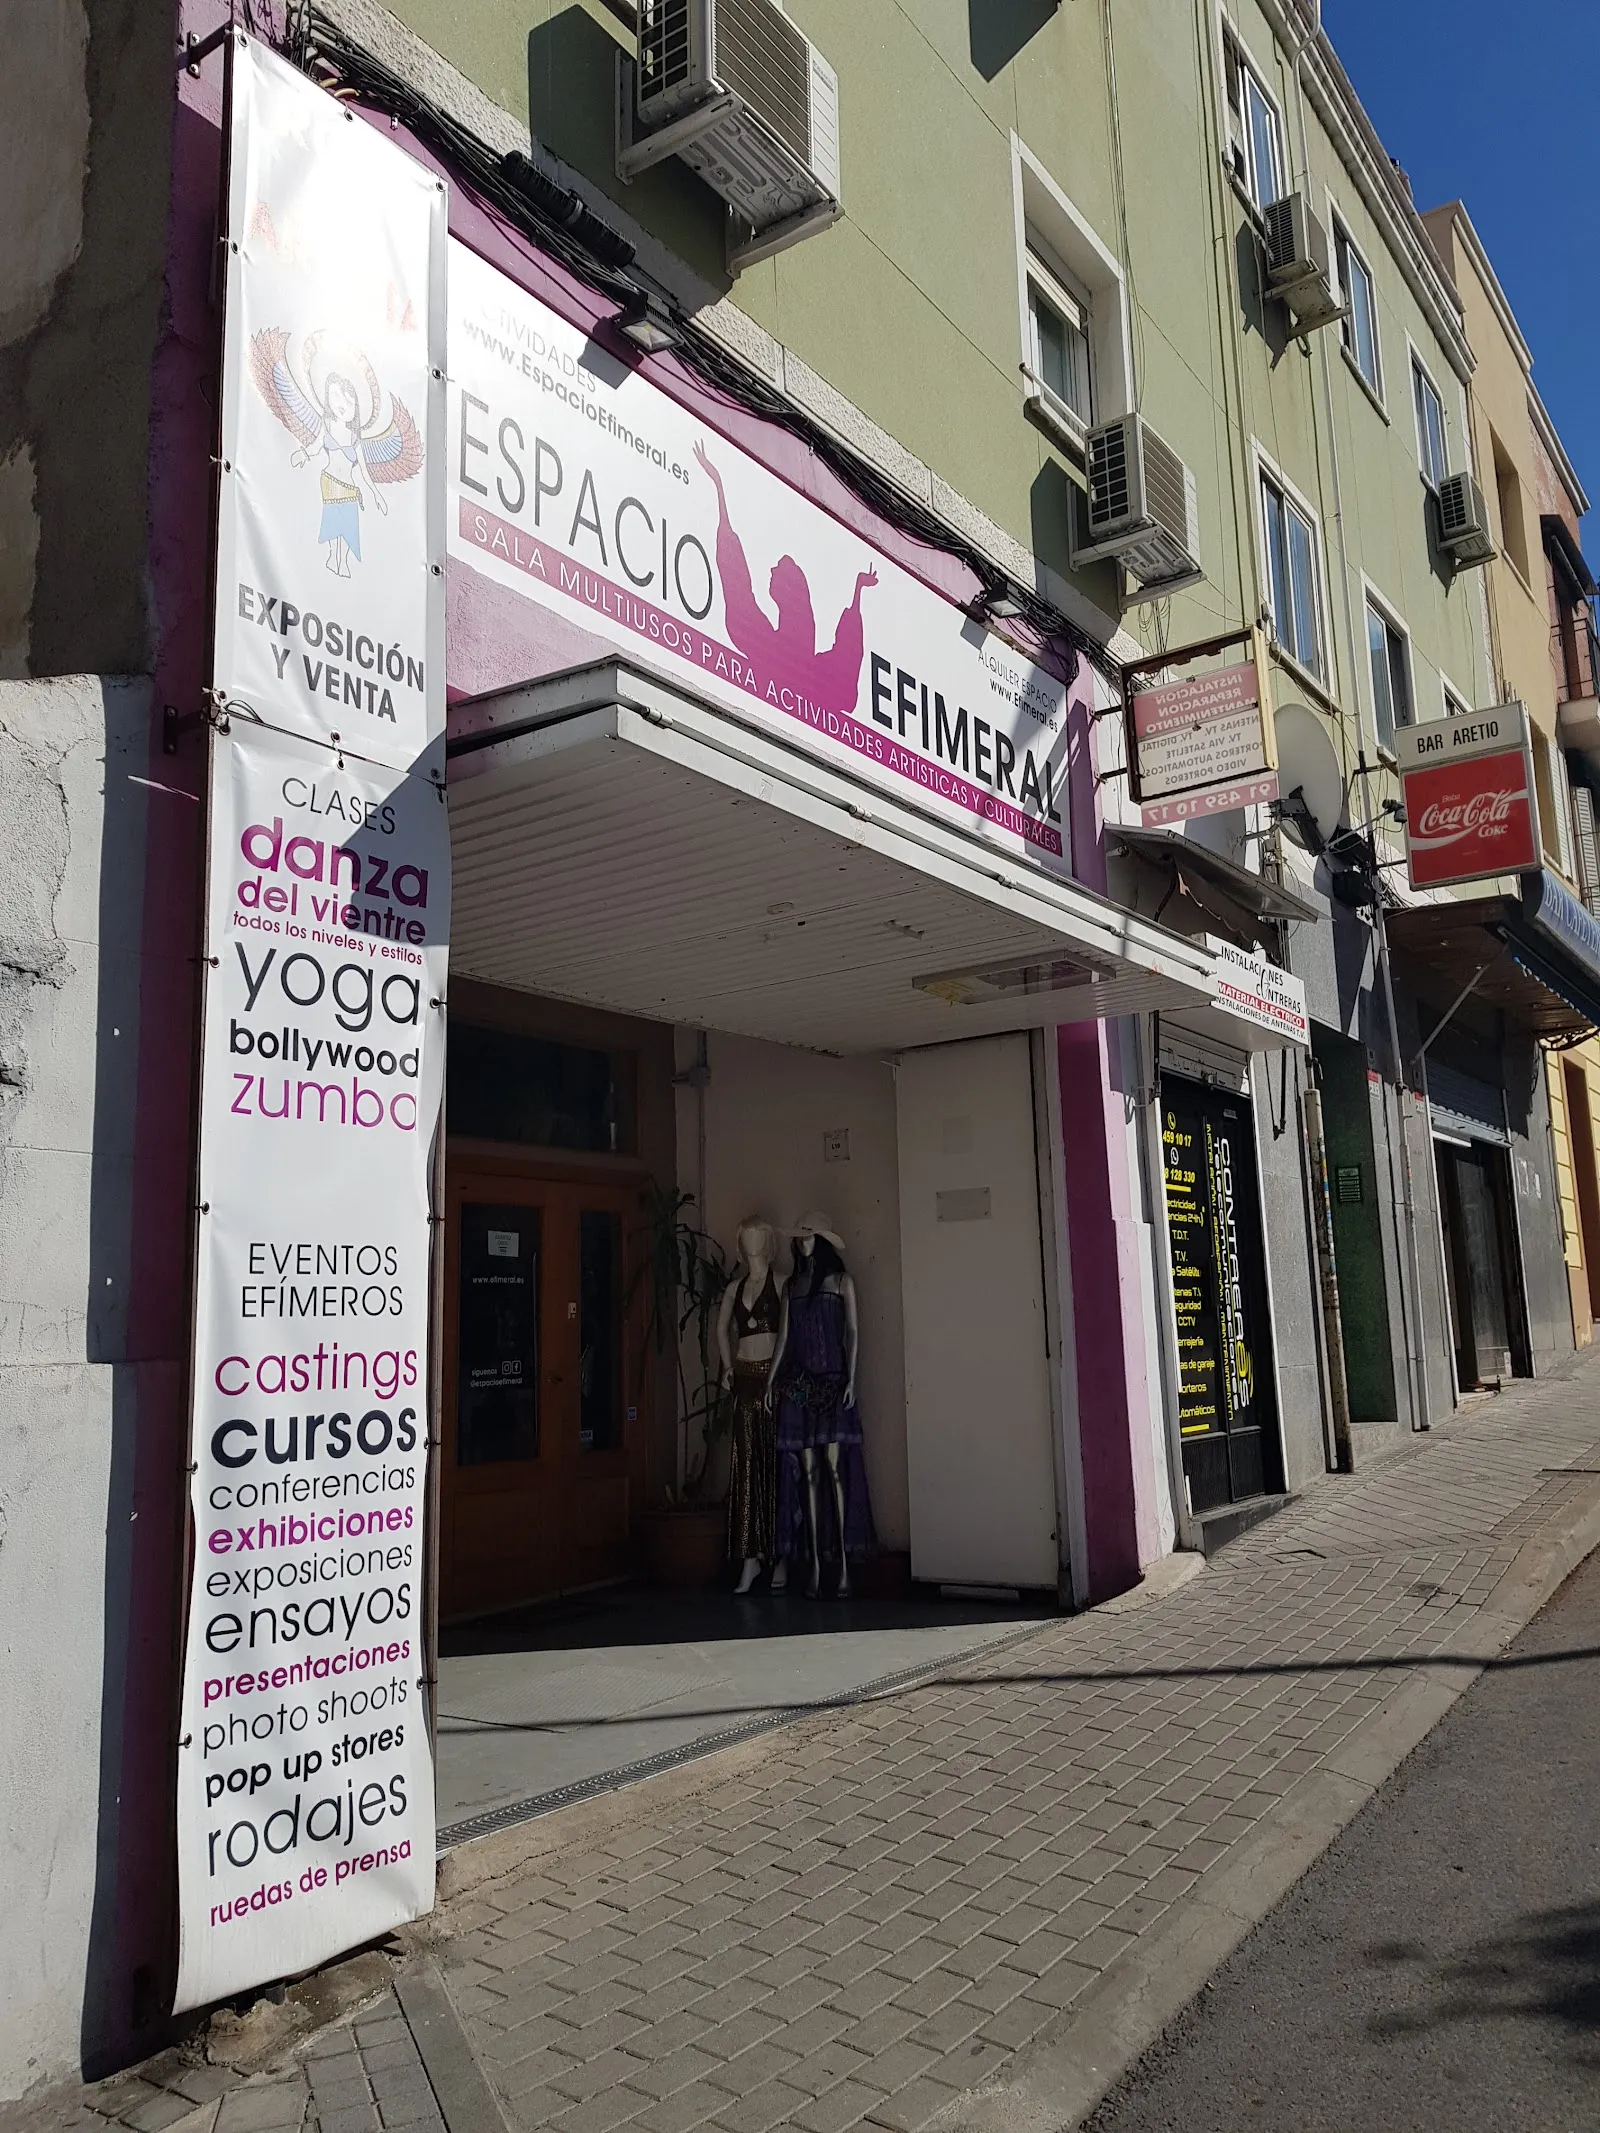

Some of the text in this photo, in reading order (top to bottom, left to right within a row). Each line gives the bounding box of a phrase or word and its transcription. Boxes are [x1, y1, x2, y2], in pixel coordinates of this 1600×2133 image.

[482, 301, 596, 393] TIVIDADES
[460, 388, 713, 621] ESPACIO
[238, 582, 425, 693] EXPOSICIÓN
[270, 641, 397, 724] Y VENTA
[473, 515, 1058, 851] SALA MULTIUSOS PARA ACTIVIDADES ARTÍSTICAS Y CULTURALES
[978, 649, 1058, 714] ALQUILER ESPACIO
[870, 650, 1061, 825] EFIMERAL
[1417, 720, 1499, 754] BAR ARETIO
[282, 777, 396, 835] CLASES
[240, 816, 429, 909] danza
[233, 910, 423, 966] todos los niveles y estilos
[237, 875, 426, 945] del vientre
[234, 941, 420, 1032] yoga
[1219, 981, 1302, 1027] MATERIAL ELECTRICO
[229, 1018, 419, 1079] bollywood
[1262, 1014, 1270, 1025] DE
[1270, 1018, 1296, 1035] ANTENAS
[230, 1072, 417, 1132] zumba
[1163, 1129, 1192, 1148] 459 10 17
[1167, 1198, 1196, 1211] ectricidad
[249, 1242, 398, 1276] EVENTOS
[241, 1275, 403, 1318] EFÍMEROS
[1175, 1300, 1202, 1313] eguridad
[1177, 1315, 1196, 1327] CCTV
[215, 1342, 418, 1400] castings
[1177, 1335, 1204, 1350] errajería
[1179, 1404, 1216, 1418] utomáticos
[1181, 1382, 1208, 1394] orteros
[210, 1407, 417, 1469] cursos
[209, 1464, 415, 1510] conferencias
[208, 1505, 414, 1554] exhibiciones
[206, 1544, 413, 1600] exposiciones
[205, 1582, 411, 1654] ensayos
[203, 1639, 410, 1708] presentaciones
[203, 1676, 408, 1760] photo shoots
[205, 1724, 404, 1808] pop up stores
[208, 1774, 407, 1877] rodajes
[209, 1839, 412, 1927] ruedas de prensa
